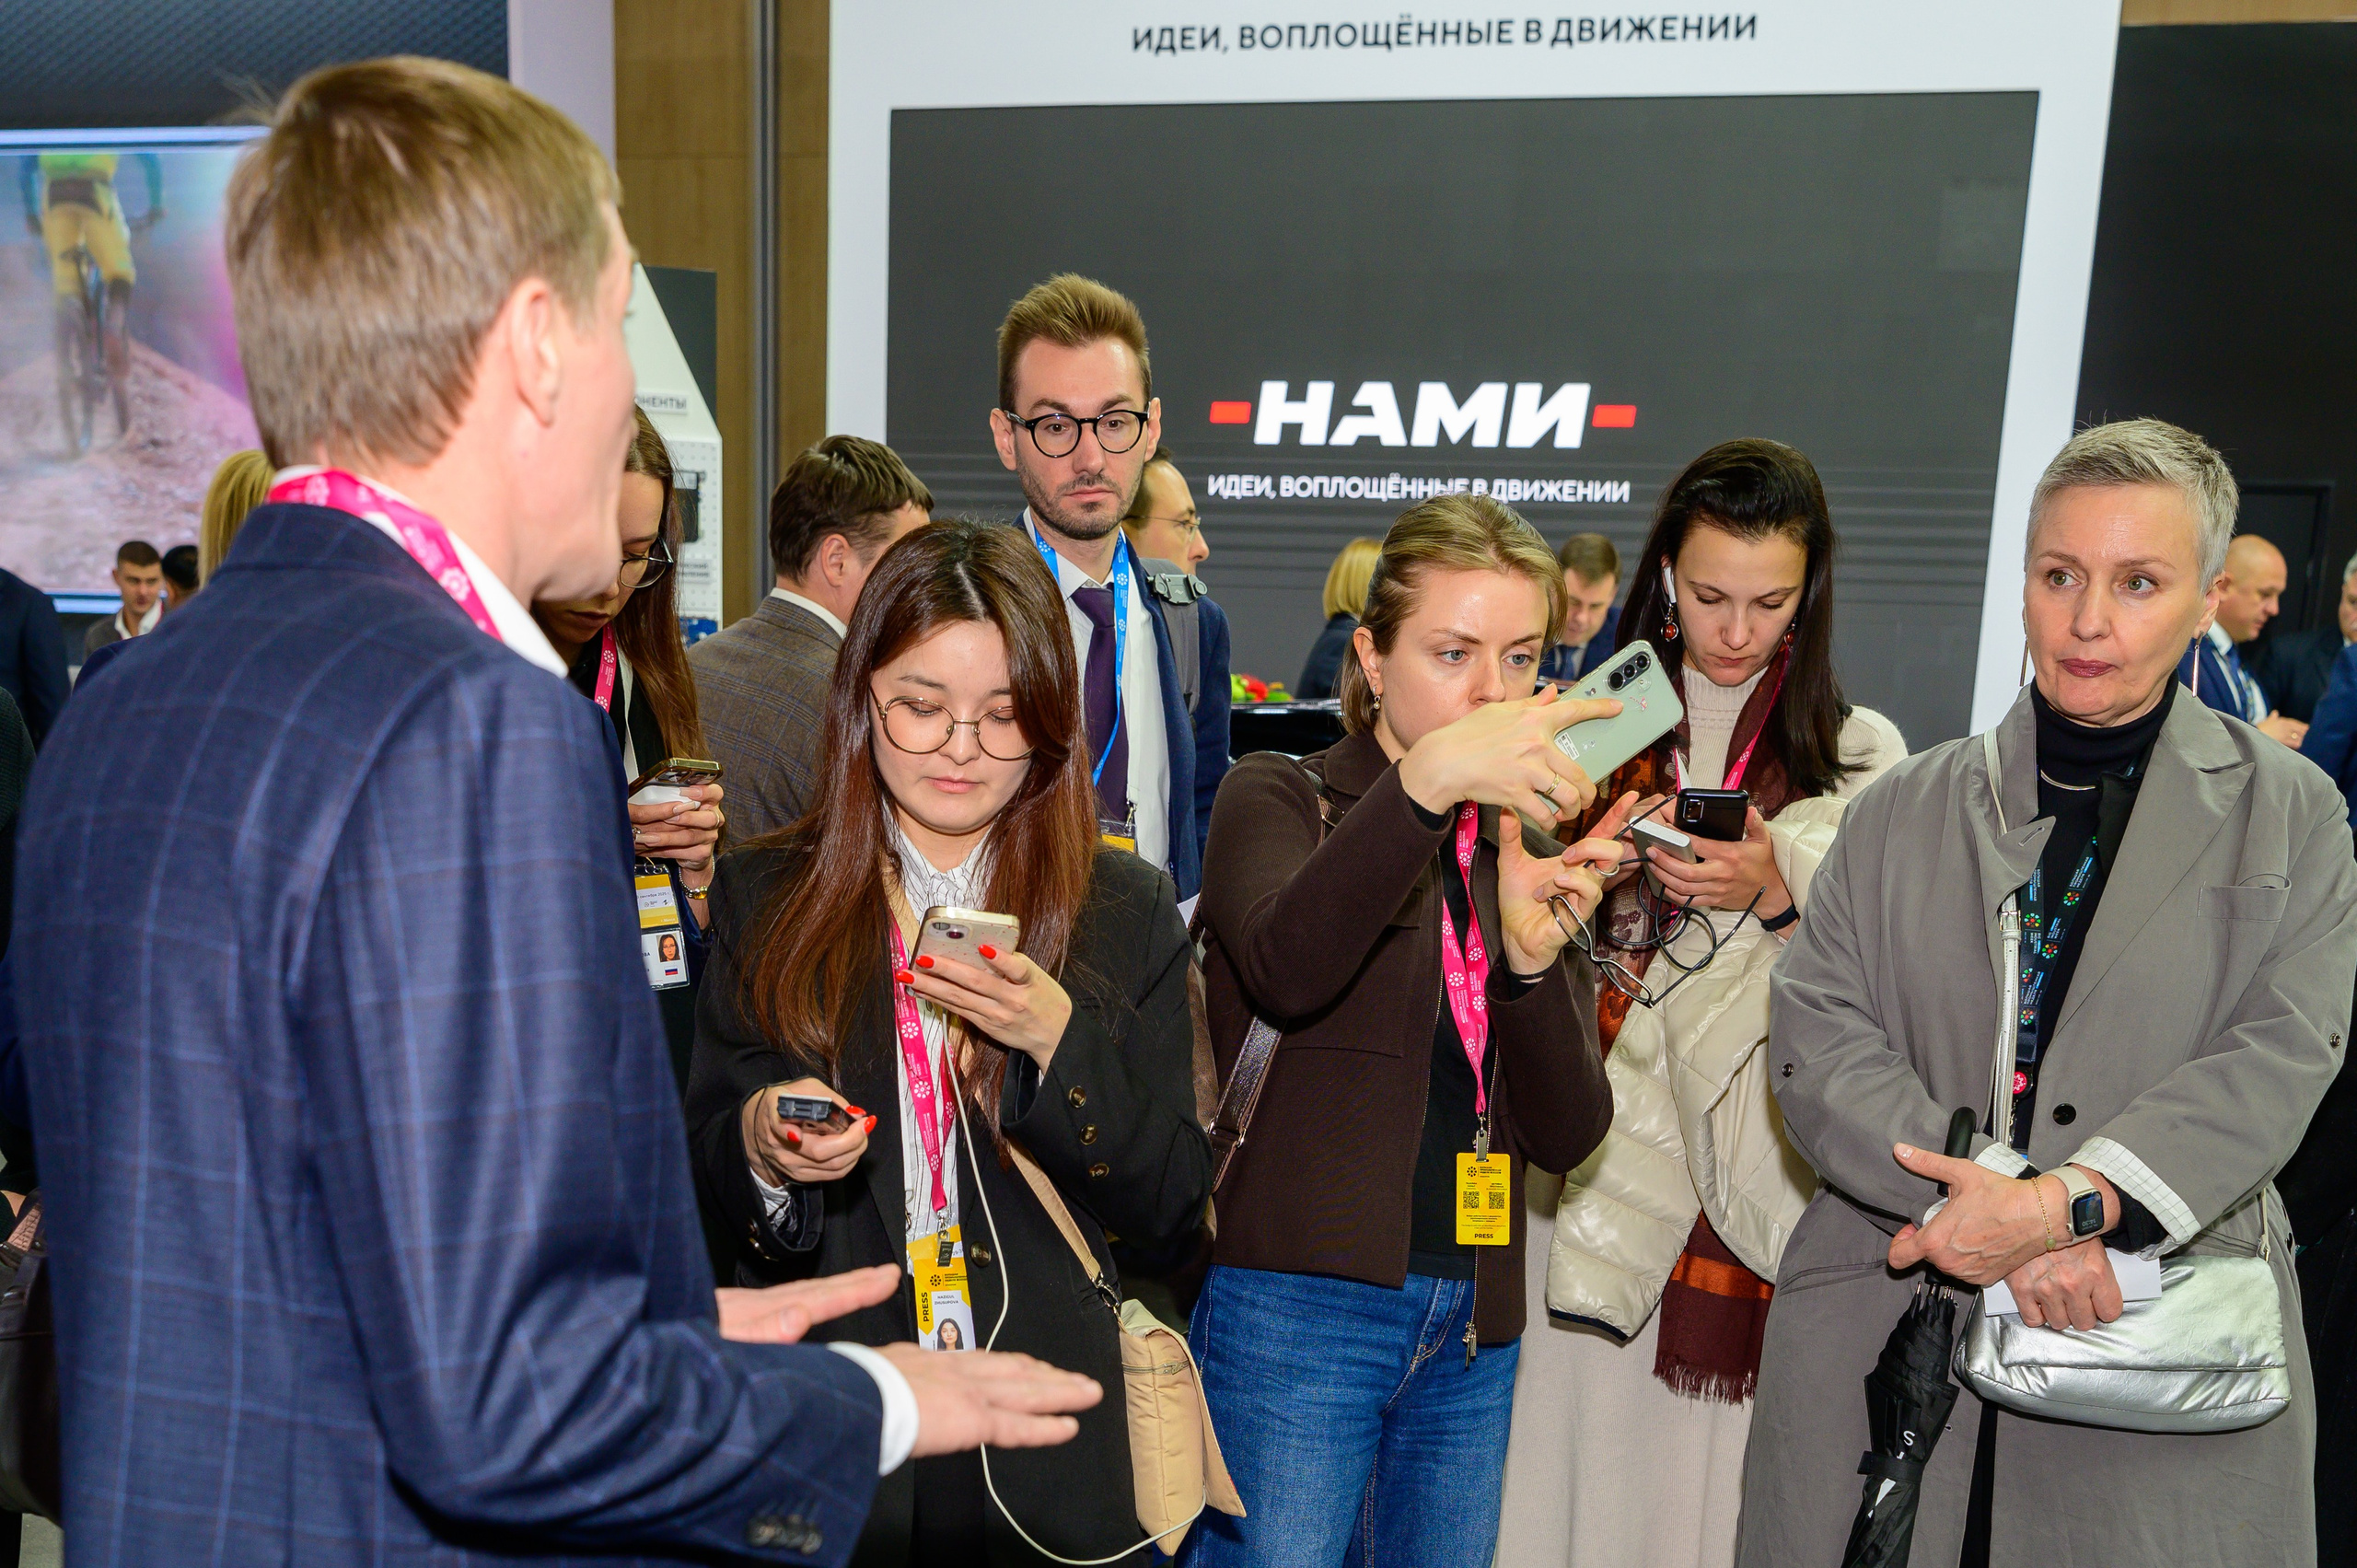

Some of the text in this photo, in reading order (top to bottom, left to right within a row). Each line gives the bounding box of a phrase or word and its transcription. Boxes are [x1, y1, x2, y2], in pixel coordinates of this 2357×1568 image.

[1133, 14, 1758, 55] ИДЕИ, ВОПЛОЩЁННЫЕ В ДВИЖЕНИИ
[1253, 380, 1591, 448] НАМИ
[1207, 474, 1277, 500] ИДЕИ,
[1280, 472, 1470, 503] ВОПЛОЩЁННЫЕ
[1490, 478, 1631, 504] ДВИЖЕНИИ
[921, 1292, 930, 1322] PRESS
